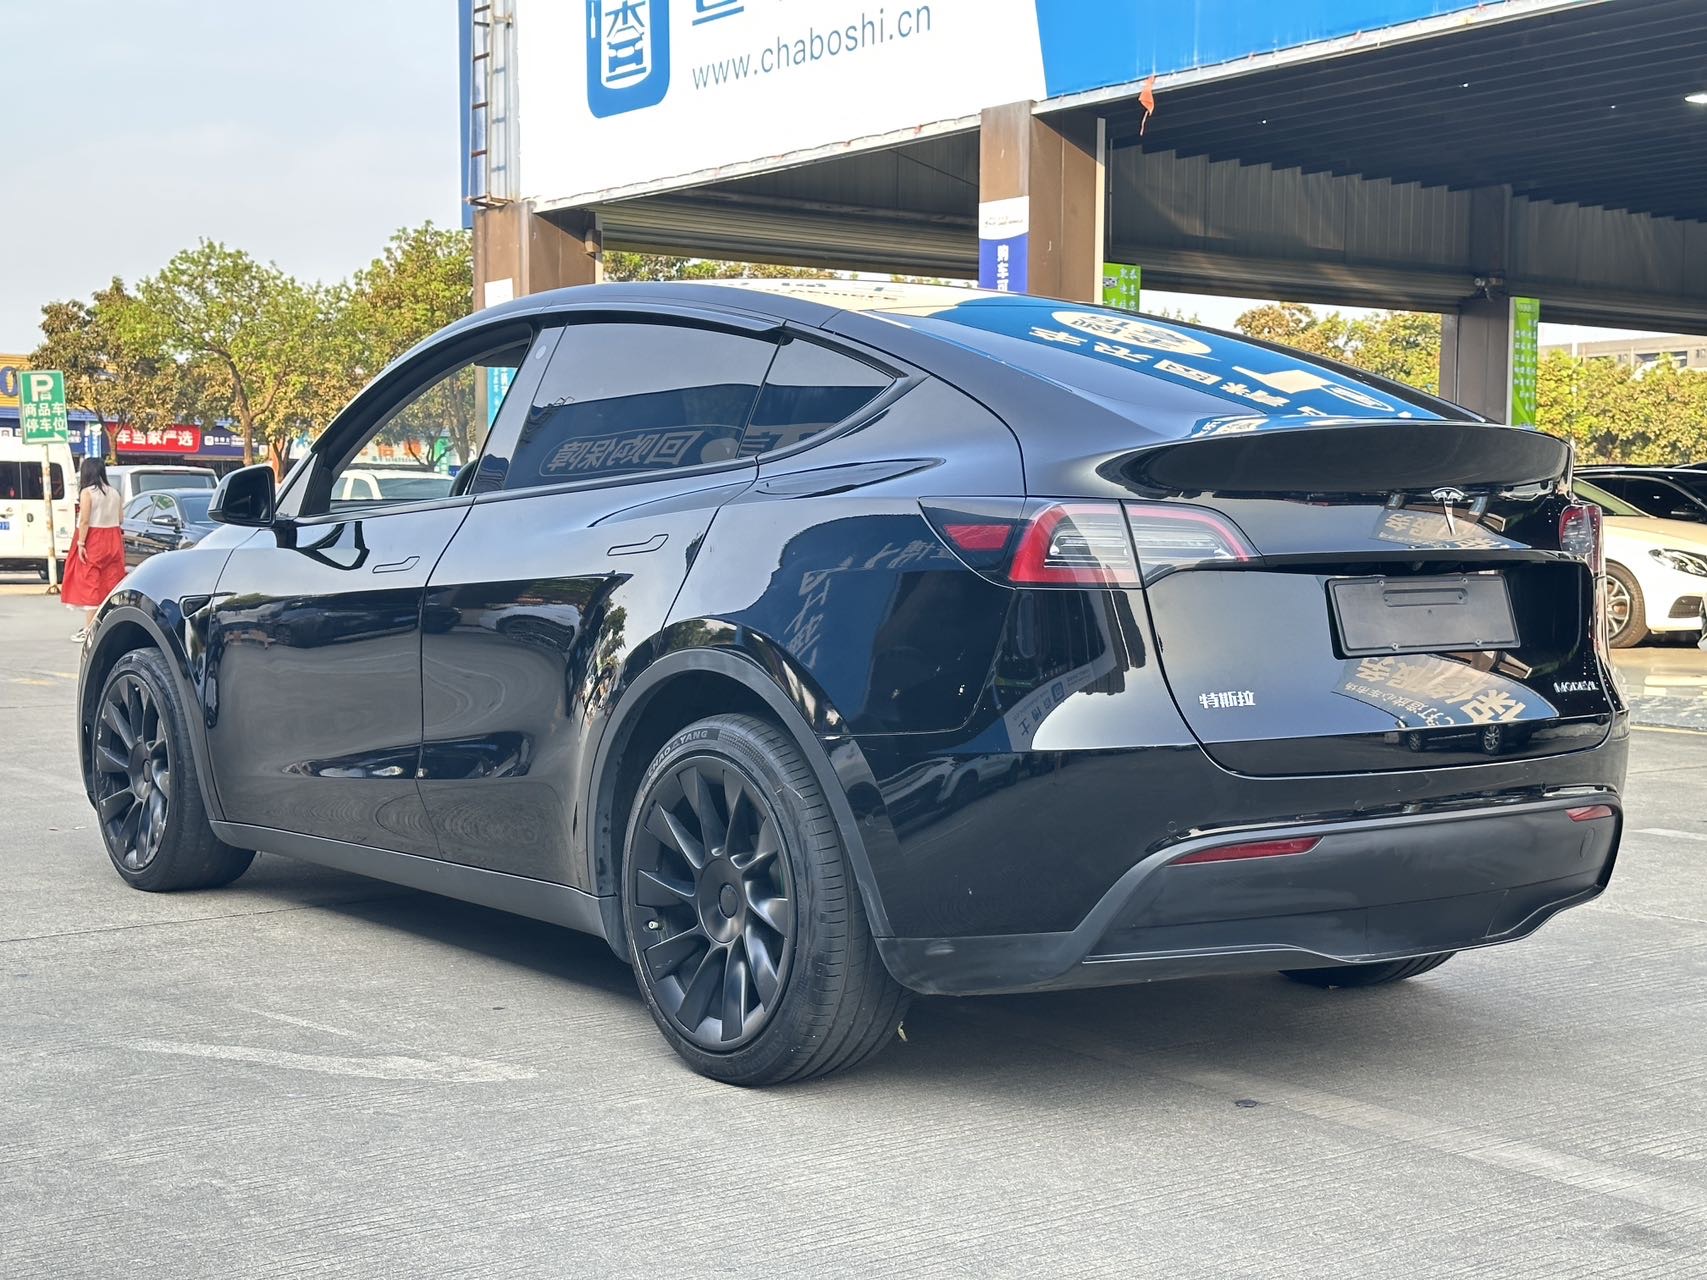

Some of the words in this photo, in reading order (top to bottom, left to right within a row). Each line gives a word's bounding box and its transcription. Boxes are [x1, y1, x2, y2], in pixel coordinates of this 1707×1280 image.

[692, 5, 931, 91] www.chaboshi.cn
[30, 374, 54, 402] P
[24, 402, 66, 418] 商品车
[26, 416, 67, 433] 停车位
[1199, 690, 1257, 709] 特斯拉
[680, 730, 708, 745] YANG
